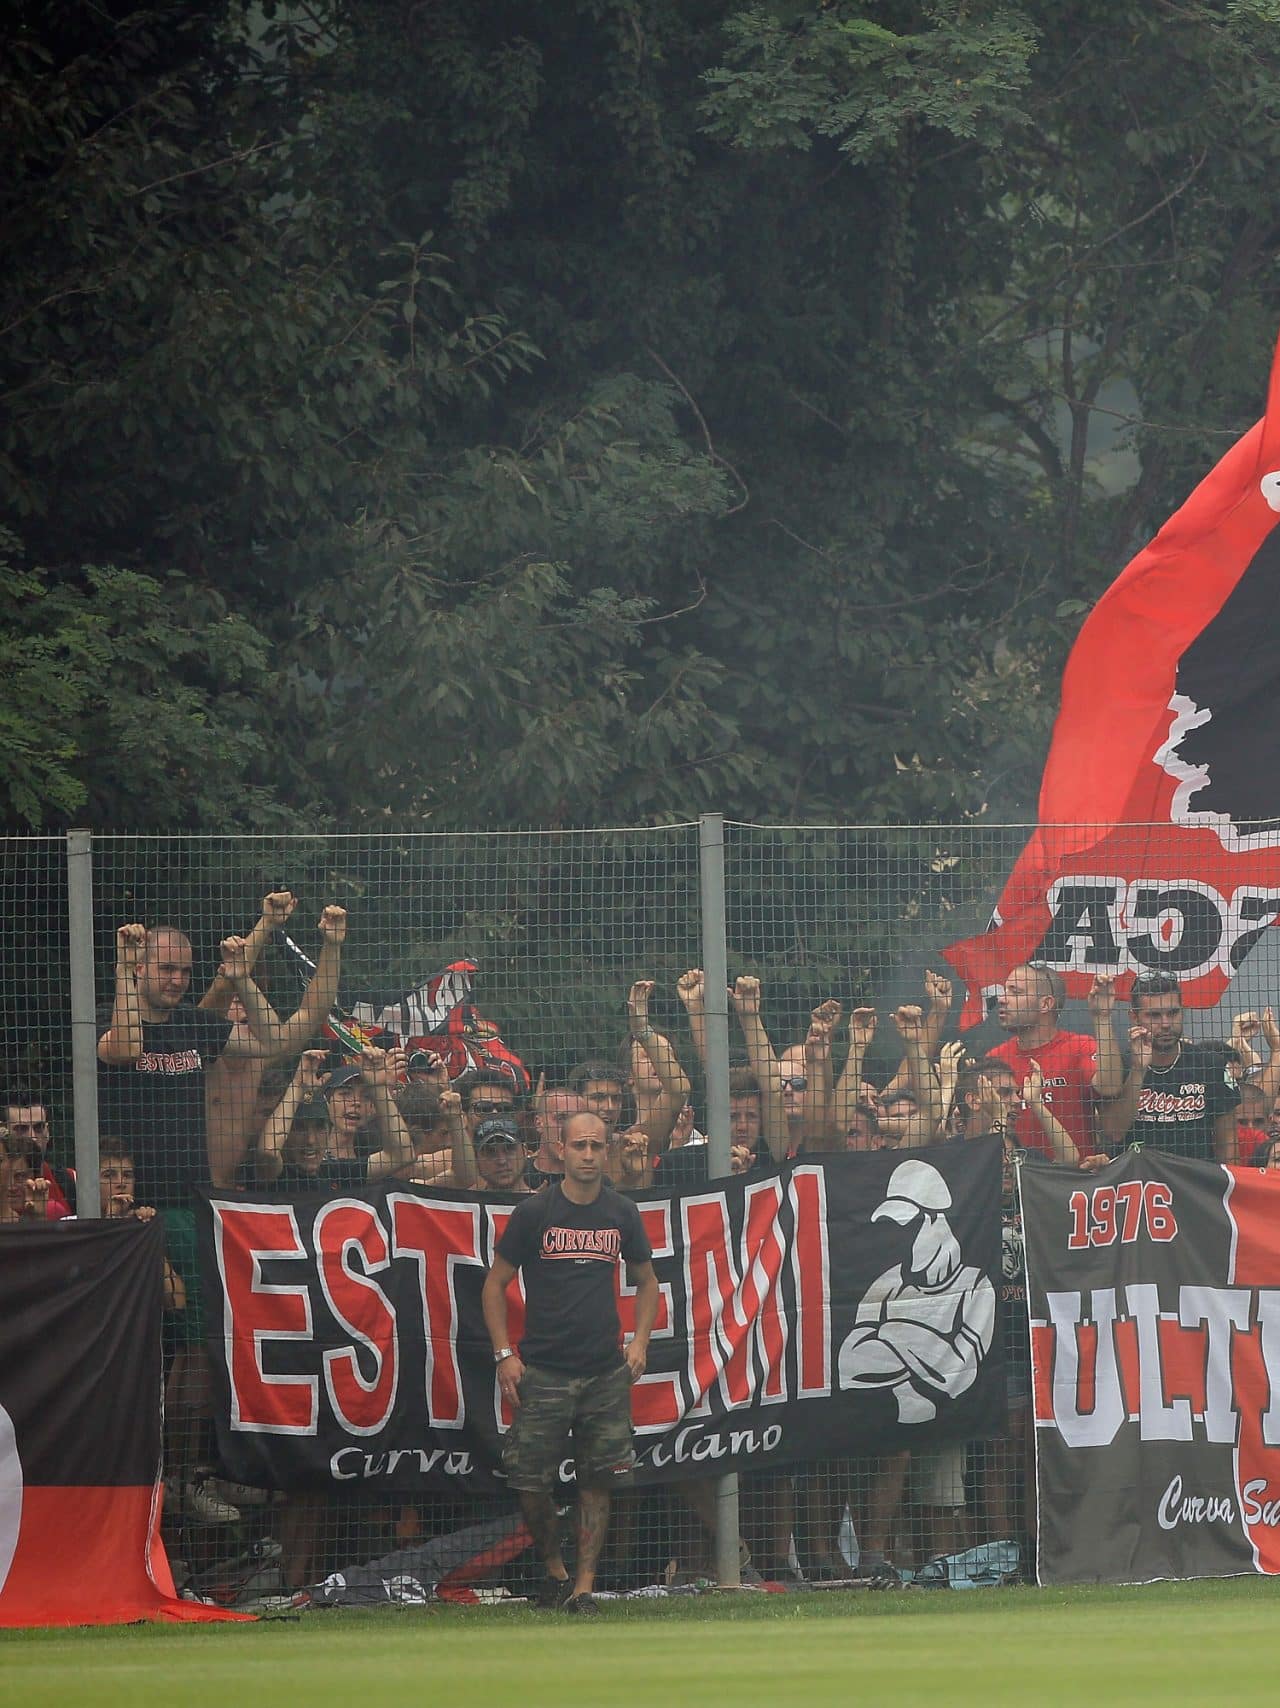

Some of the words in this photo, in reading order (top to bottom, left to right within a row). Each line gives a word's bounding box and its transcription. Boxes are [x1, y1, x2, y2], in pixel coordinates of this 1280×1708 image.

[1068, 1181, 1178, 1250] 1976
[211, 1164, 831, 1436] ESTEMI
[330, 1446, 474, 1481] Curva
[1157, 1474, 1235, 1530] Curva
